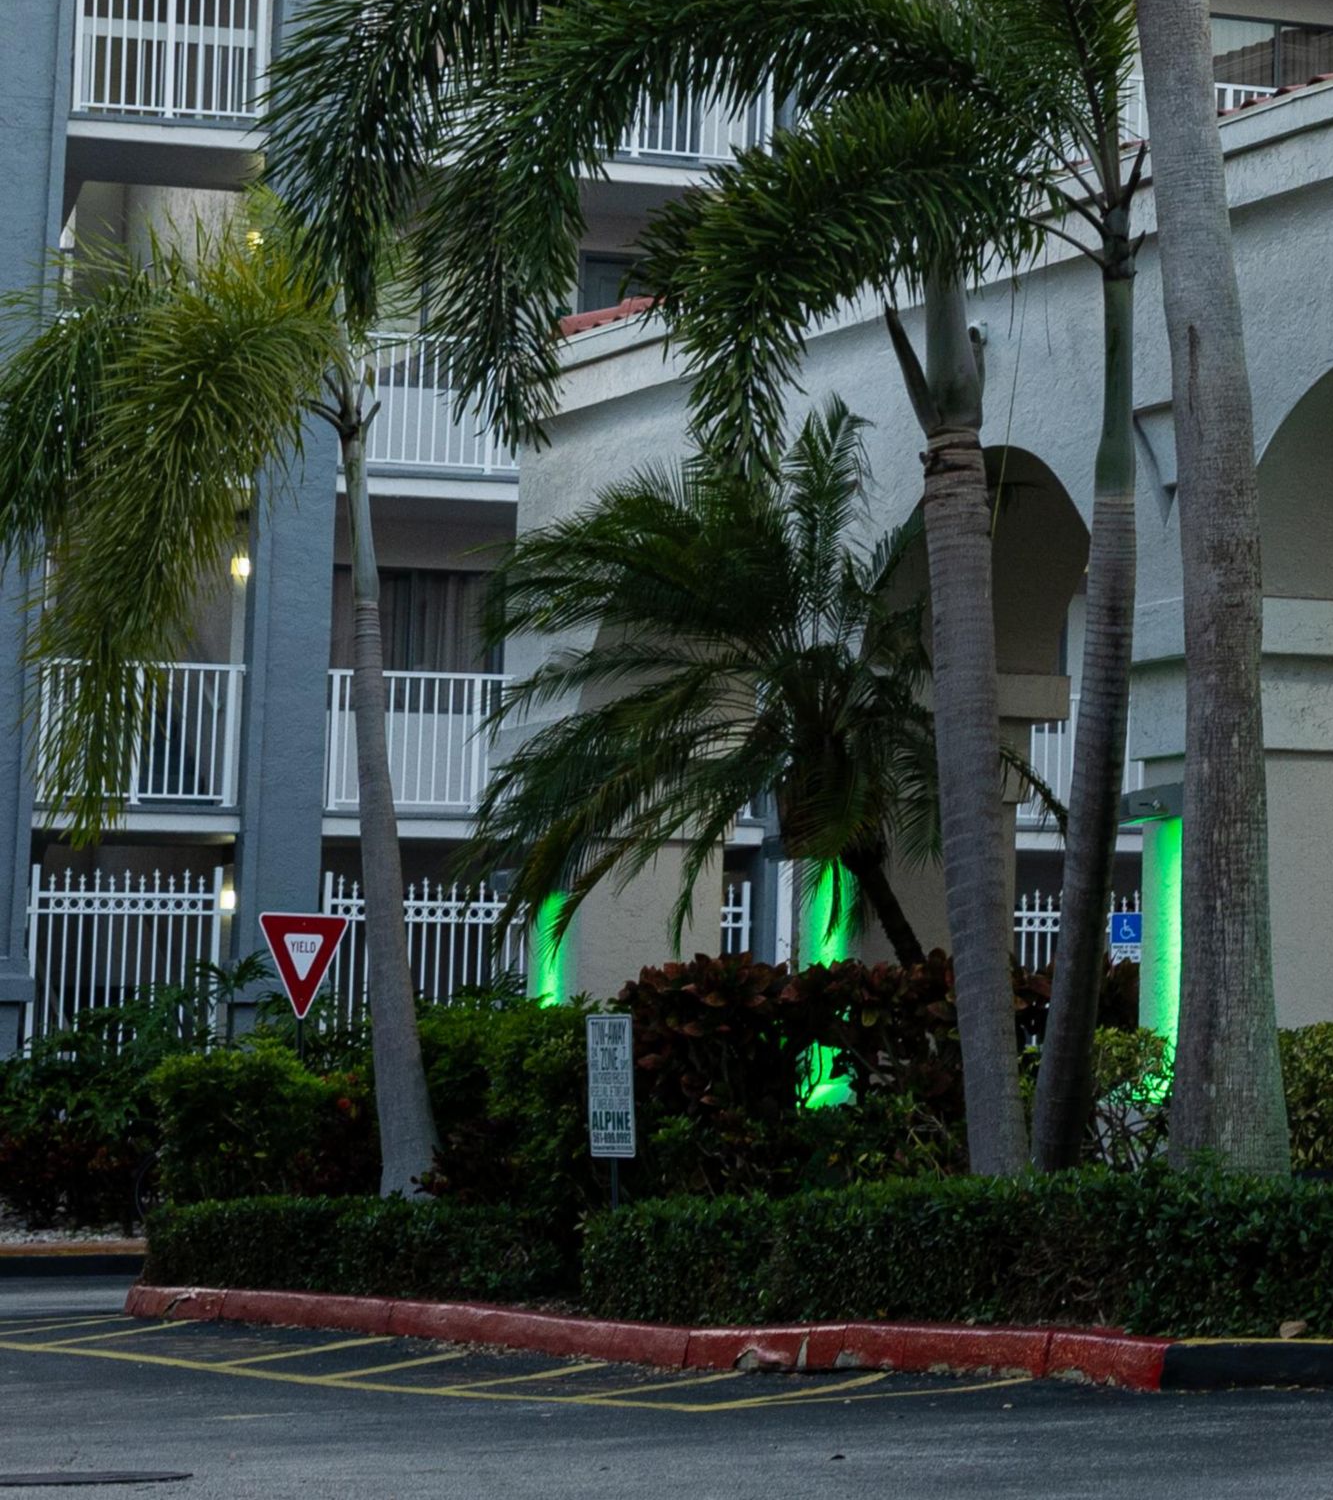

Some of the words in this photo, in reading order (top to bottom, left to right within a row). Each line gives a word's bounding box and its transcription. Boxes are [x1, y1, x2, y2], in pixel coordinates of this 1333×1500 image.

[291, 940, 316, 953] YIELD
[591, 1020, 627, 1045] TOW-AWAY
[600, 1047, 618, 1071] ZONE
[592, 1111, 631, 1131] ALPINE
